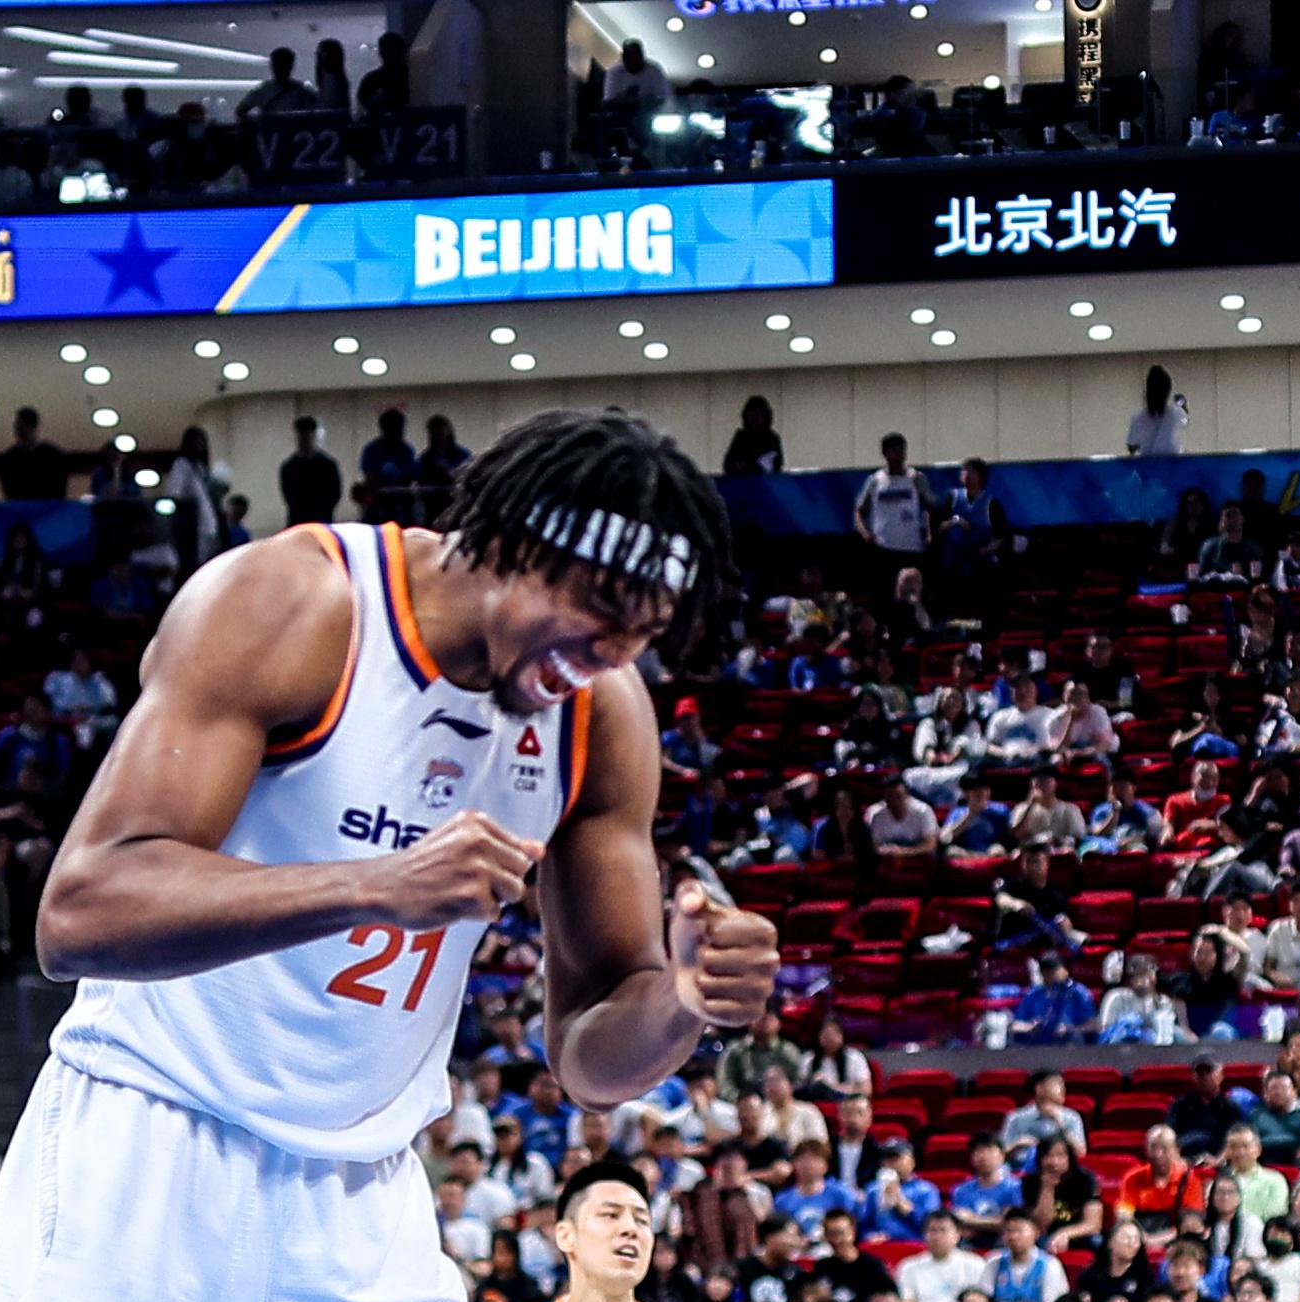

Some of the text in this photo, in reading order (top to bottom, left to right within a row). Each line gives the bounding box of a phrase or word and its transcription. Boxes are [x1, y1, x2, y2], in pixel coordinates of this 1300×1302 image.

[292, 129, 340, 169] 22
[413, 203, 674, 289] BEIJING
[933, 186, 1179, 258] 北京北汽
[338, 804, 430, 850] sha
[325, 922, 447, 1013] 21
